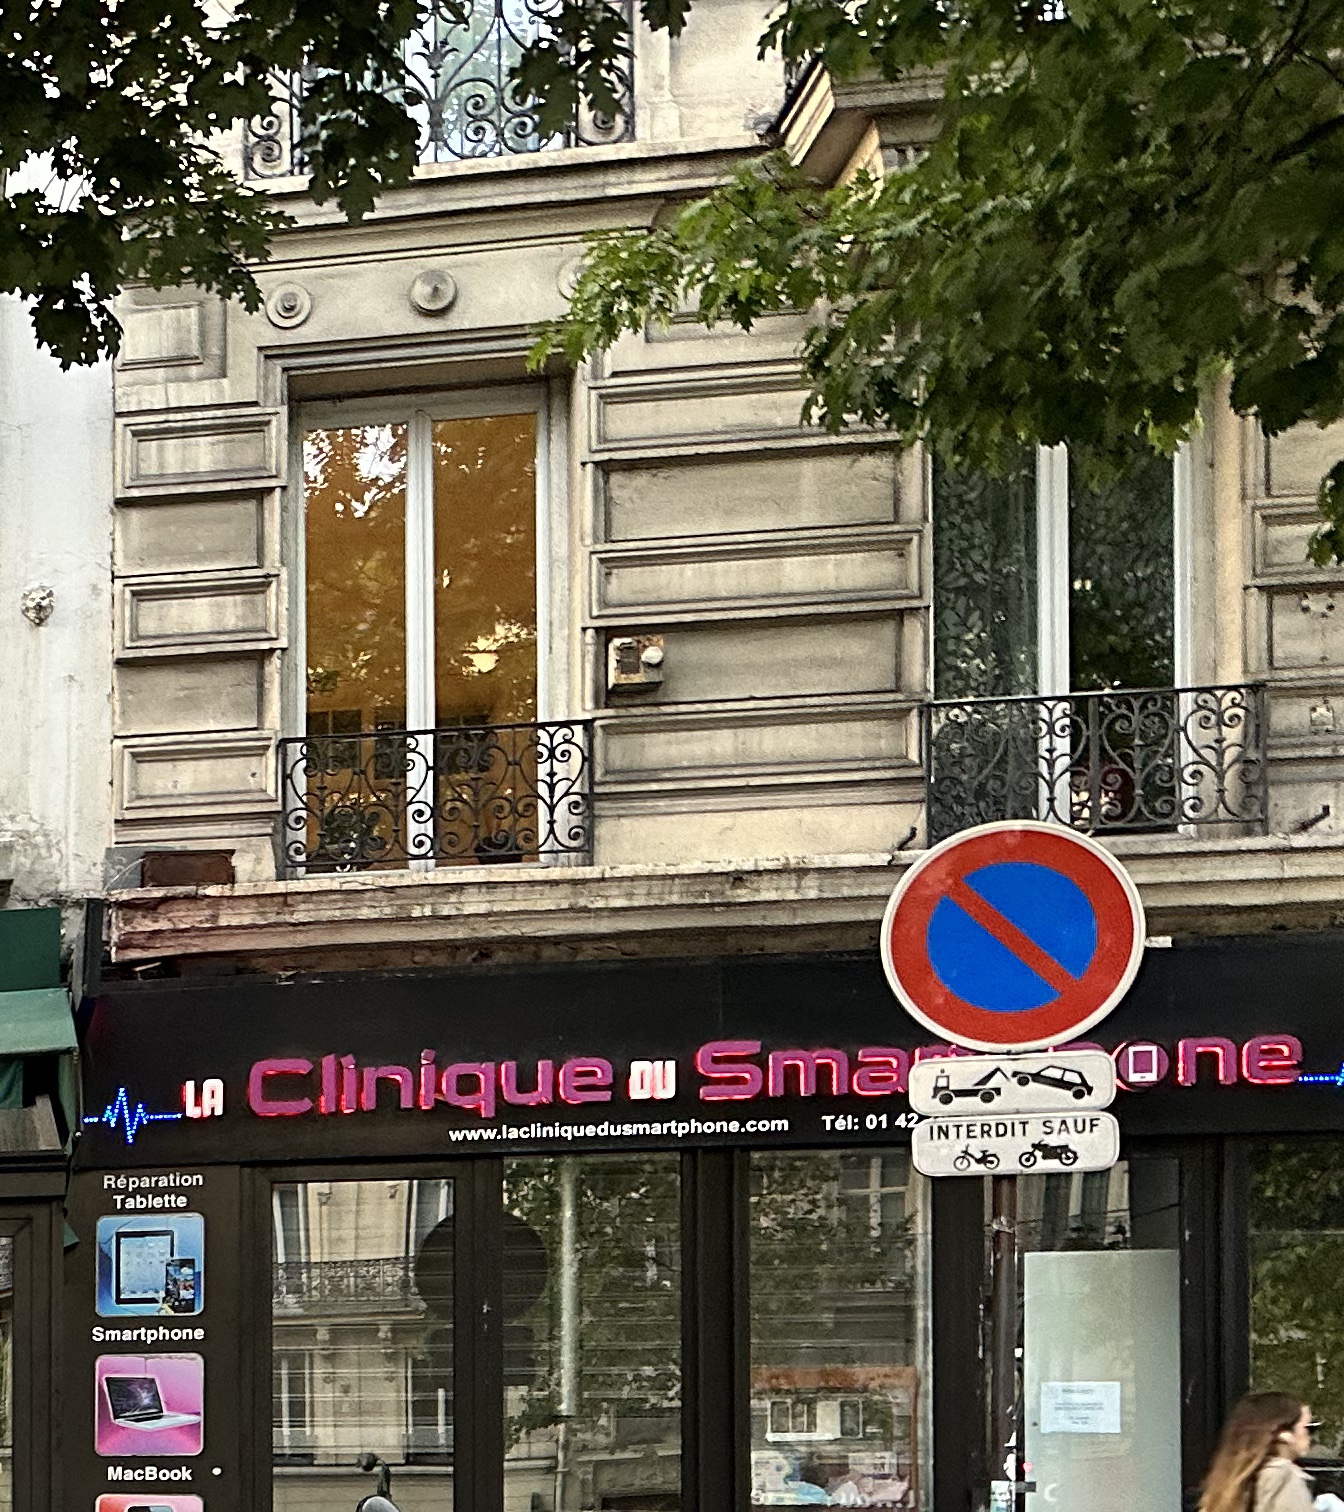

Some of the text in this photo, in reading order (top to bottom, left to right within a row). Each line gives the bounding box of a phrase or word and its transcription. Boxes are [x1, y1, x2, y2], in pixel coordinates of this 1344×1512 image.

[182, 1078, 224, 1119] LA
[248, 1048, 613, 1118] Clinique
[628, 1059, 677, 1100] DU
[448, 1112, 920, 1142] www.lacliniquedusmartphone.com Tél: 01 42
[929, 1117, 1101, 1141] INTERDIT SAUF
[103, 1171, 204, 1192] Réparation
[112, 1193, 188, 1210] Tablette
[92, 1325, 205, 1345] Smartphone
[106, 1465, 193, 1482] MacBook
